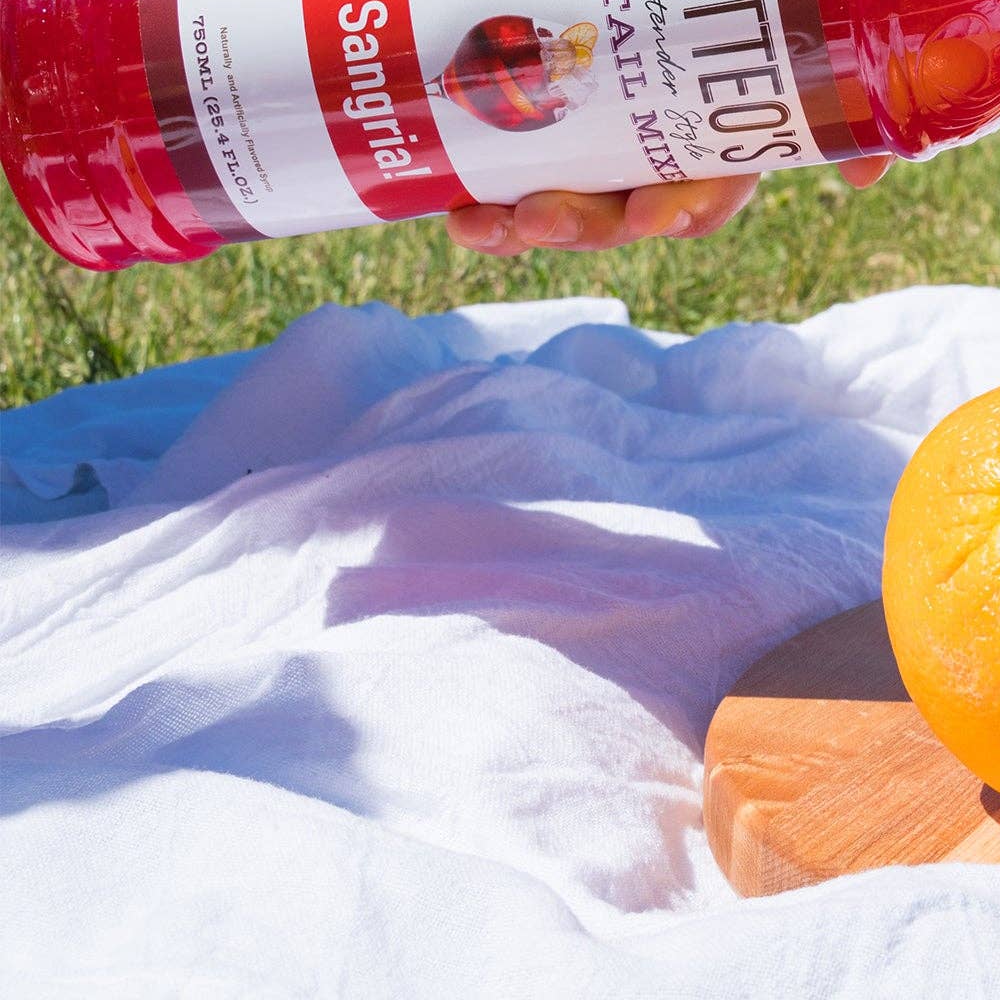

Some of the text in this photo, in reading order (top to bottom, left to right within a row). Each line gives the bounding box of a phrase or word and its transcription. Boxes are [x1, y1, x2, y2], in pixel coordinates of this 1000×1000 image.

[192, 15, 259, 204] 750ML (25.4 FL.OZ.)
[219, 26, 274, 193] Naturally and Artificially Flavored Syrup
[338, 0, 432, 180] Sangria!
[630, 109, 688, 181] MIXE
[664, 108, 715, 160] Style
